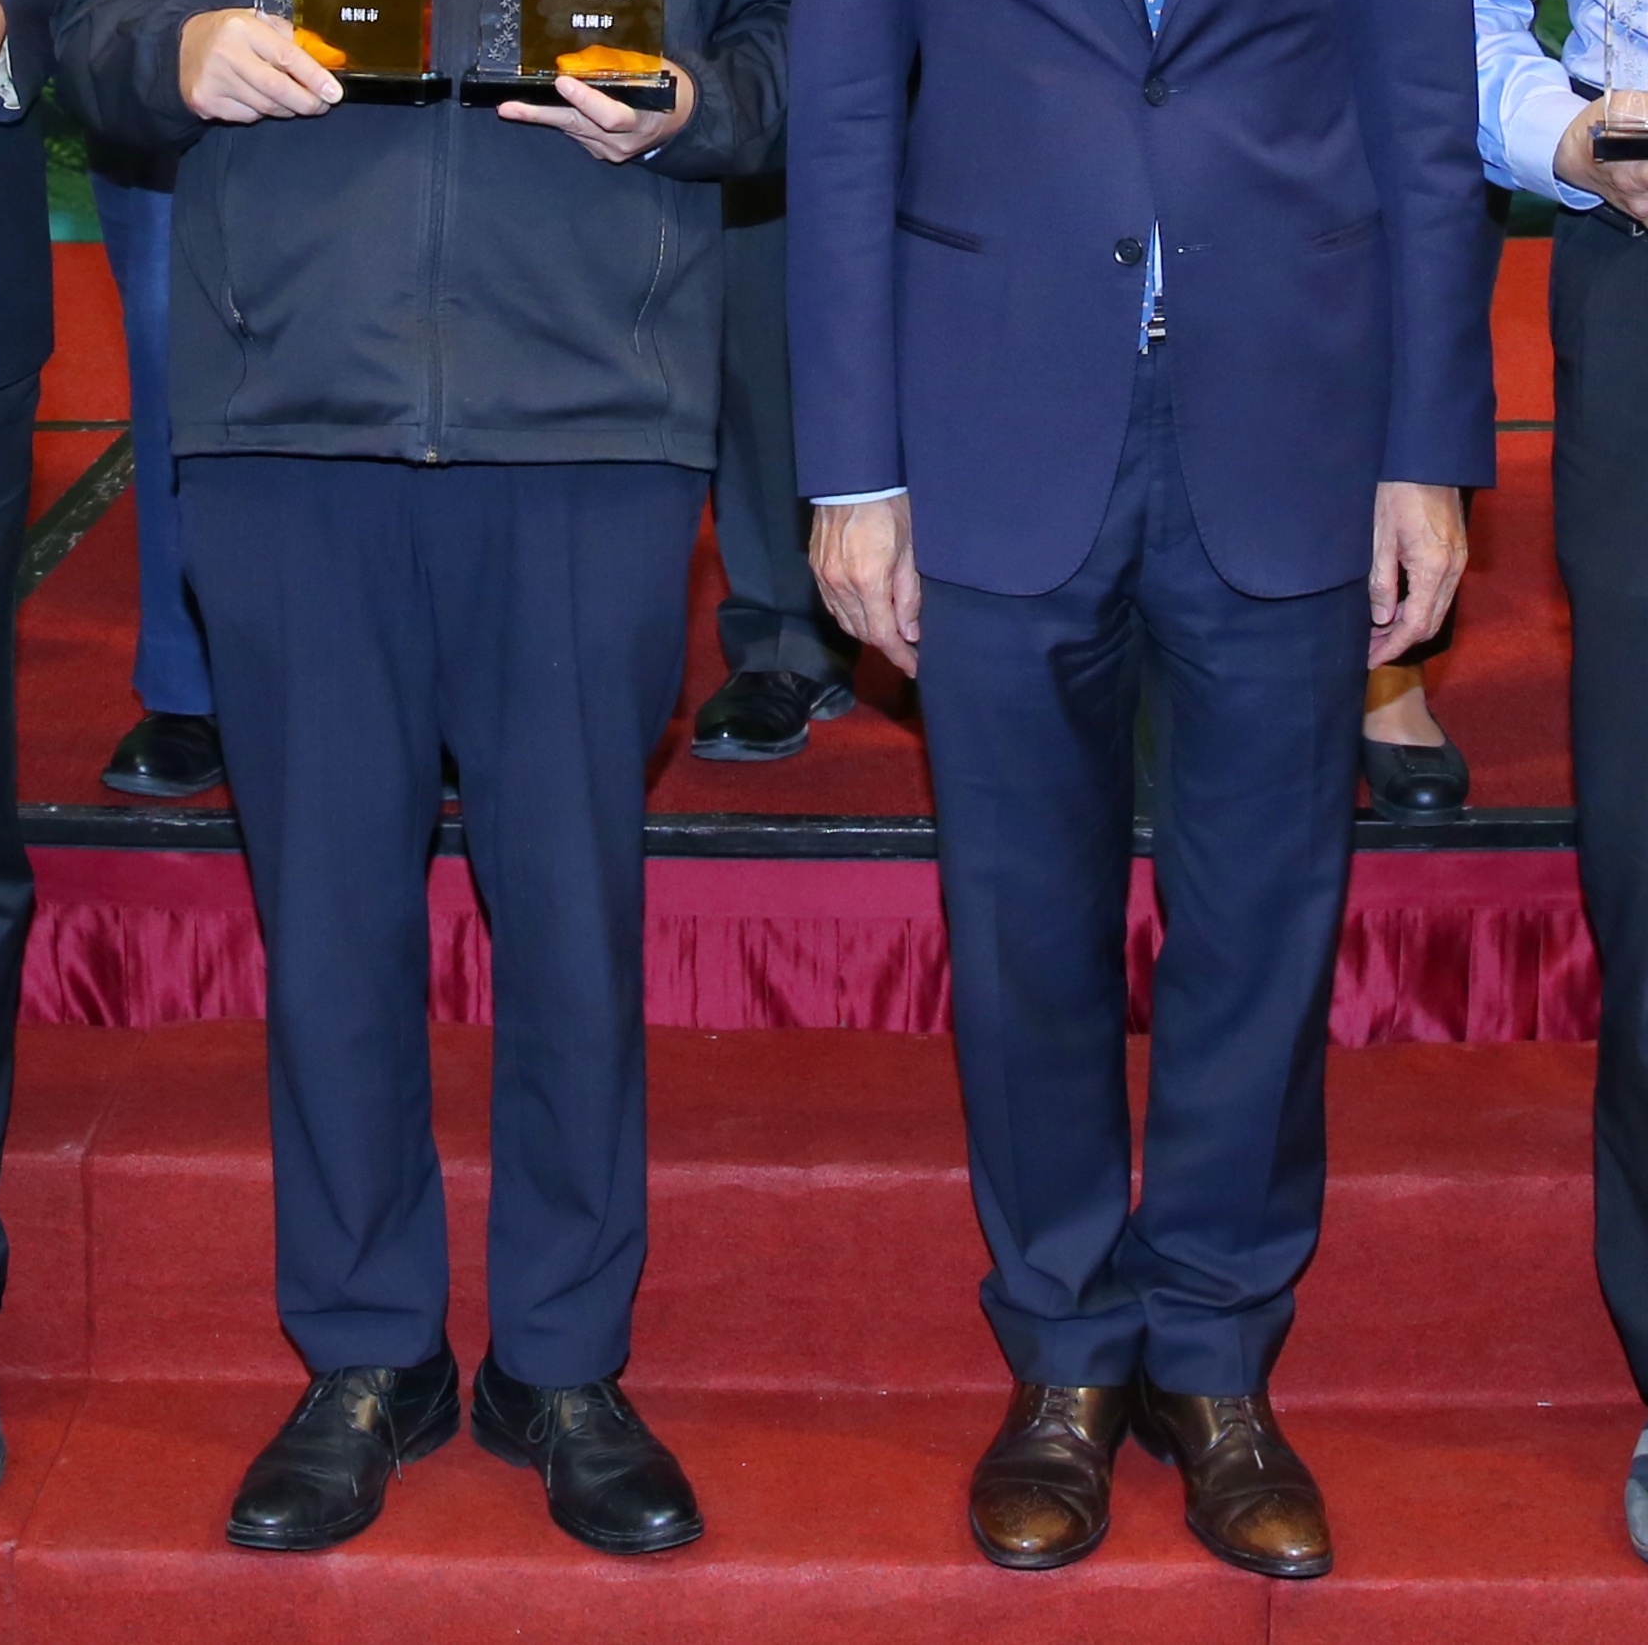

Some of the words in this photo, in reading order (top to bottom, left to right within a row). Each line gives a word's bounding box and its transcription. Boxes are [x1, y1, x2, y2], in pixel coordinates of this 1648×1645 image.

[340, 8, 379, 22] 桃園市
[571, 13, 613, 29] 桃園市
